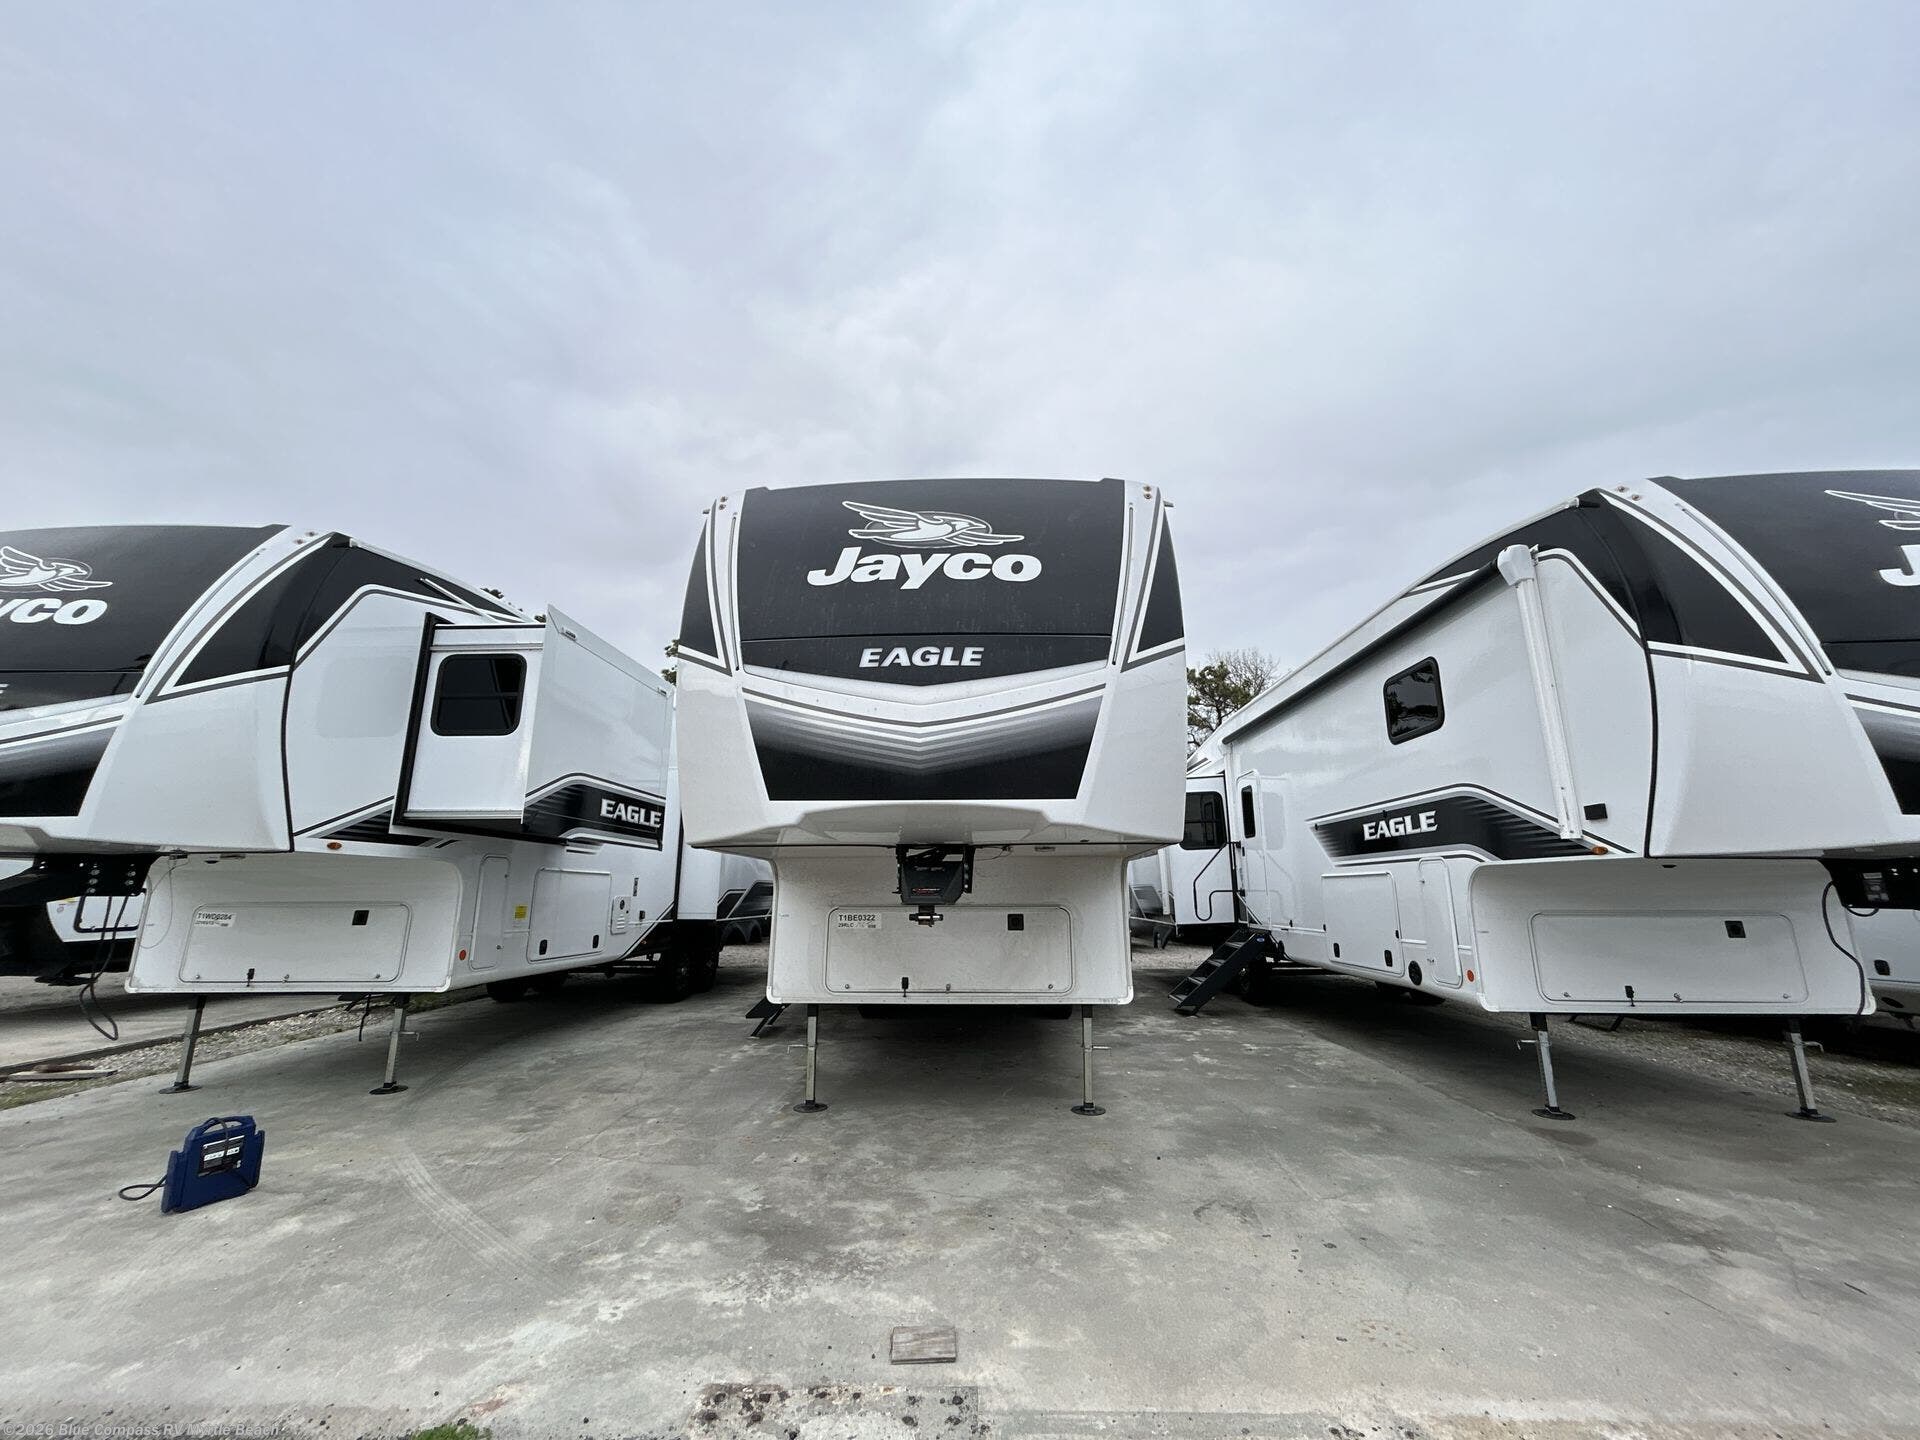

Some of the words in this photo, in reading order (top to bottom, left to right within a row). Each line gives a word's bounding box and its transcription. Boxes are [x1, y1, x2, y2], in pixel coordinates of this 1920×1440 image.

[807, 546, 1042, 590] Jayco
[859, 646, 984, 668] EAGLE
[600, 798, 662, 828] EAGLE
[1362, 810, 1438, 841] EAGLE
